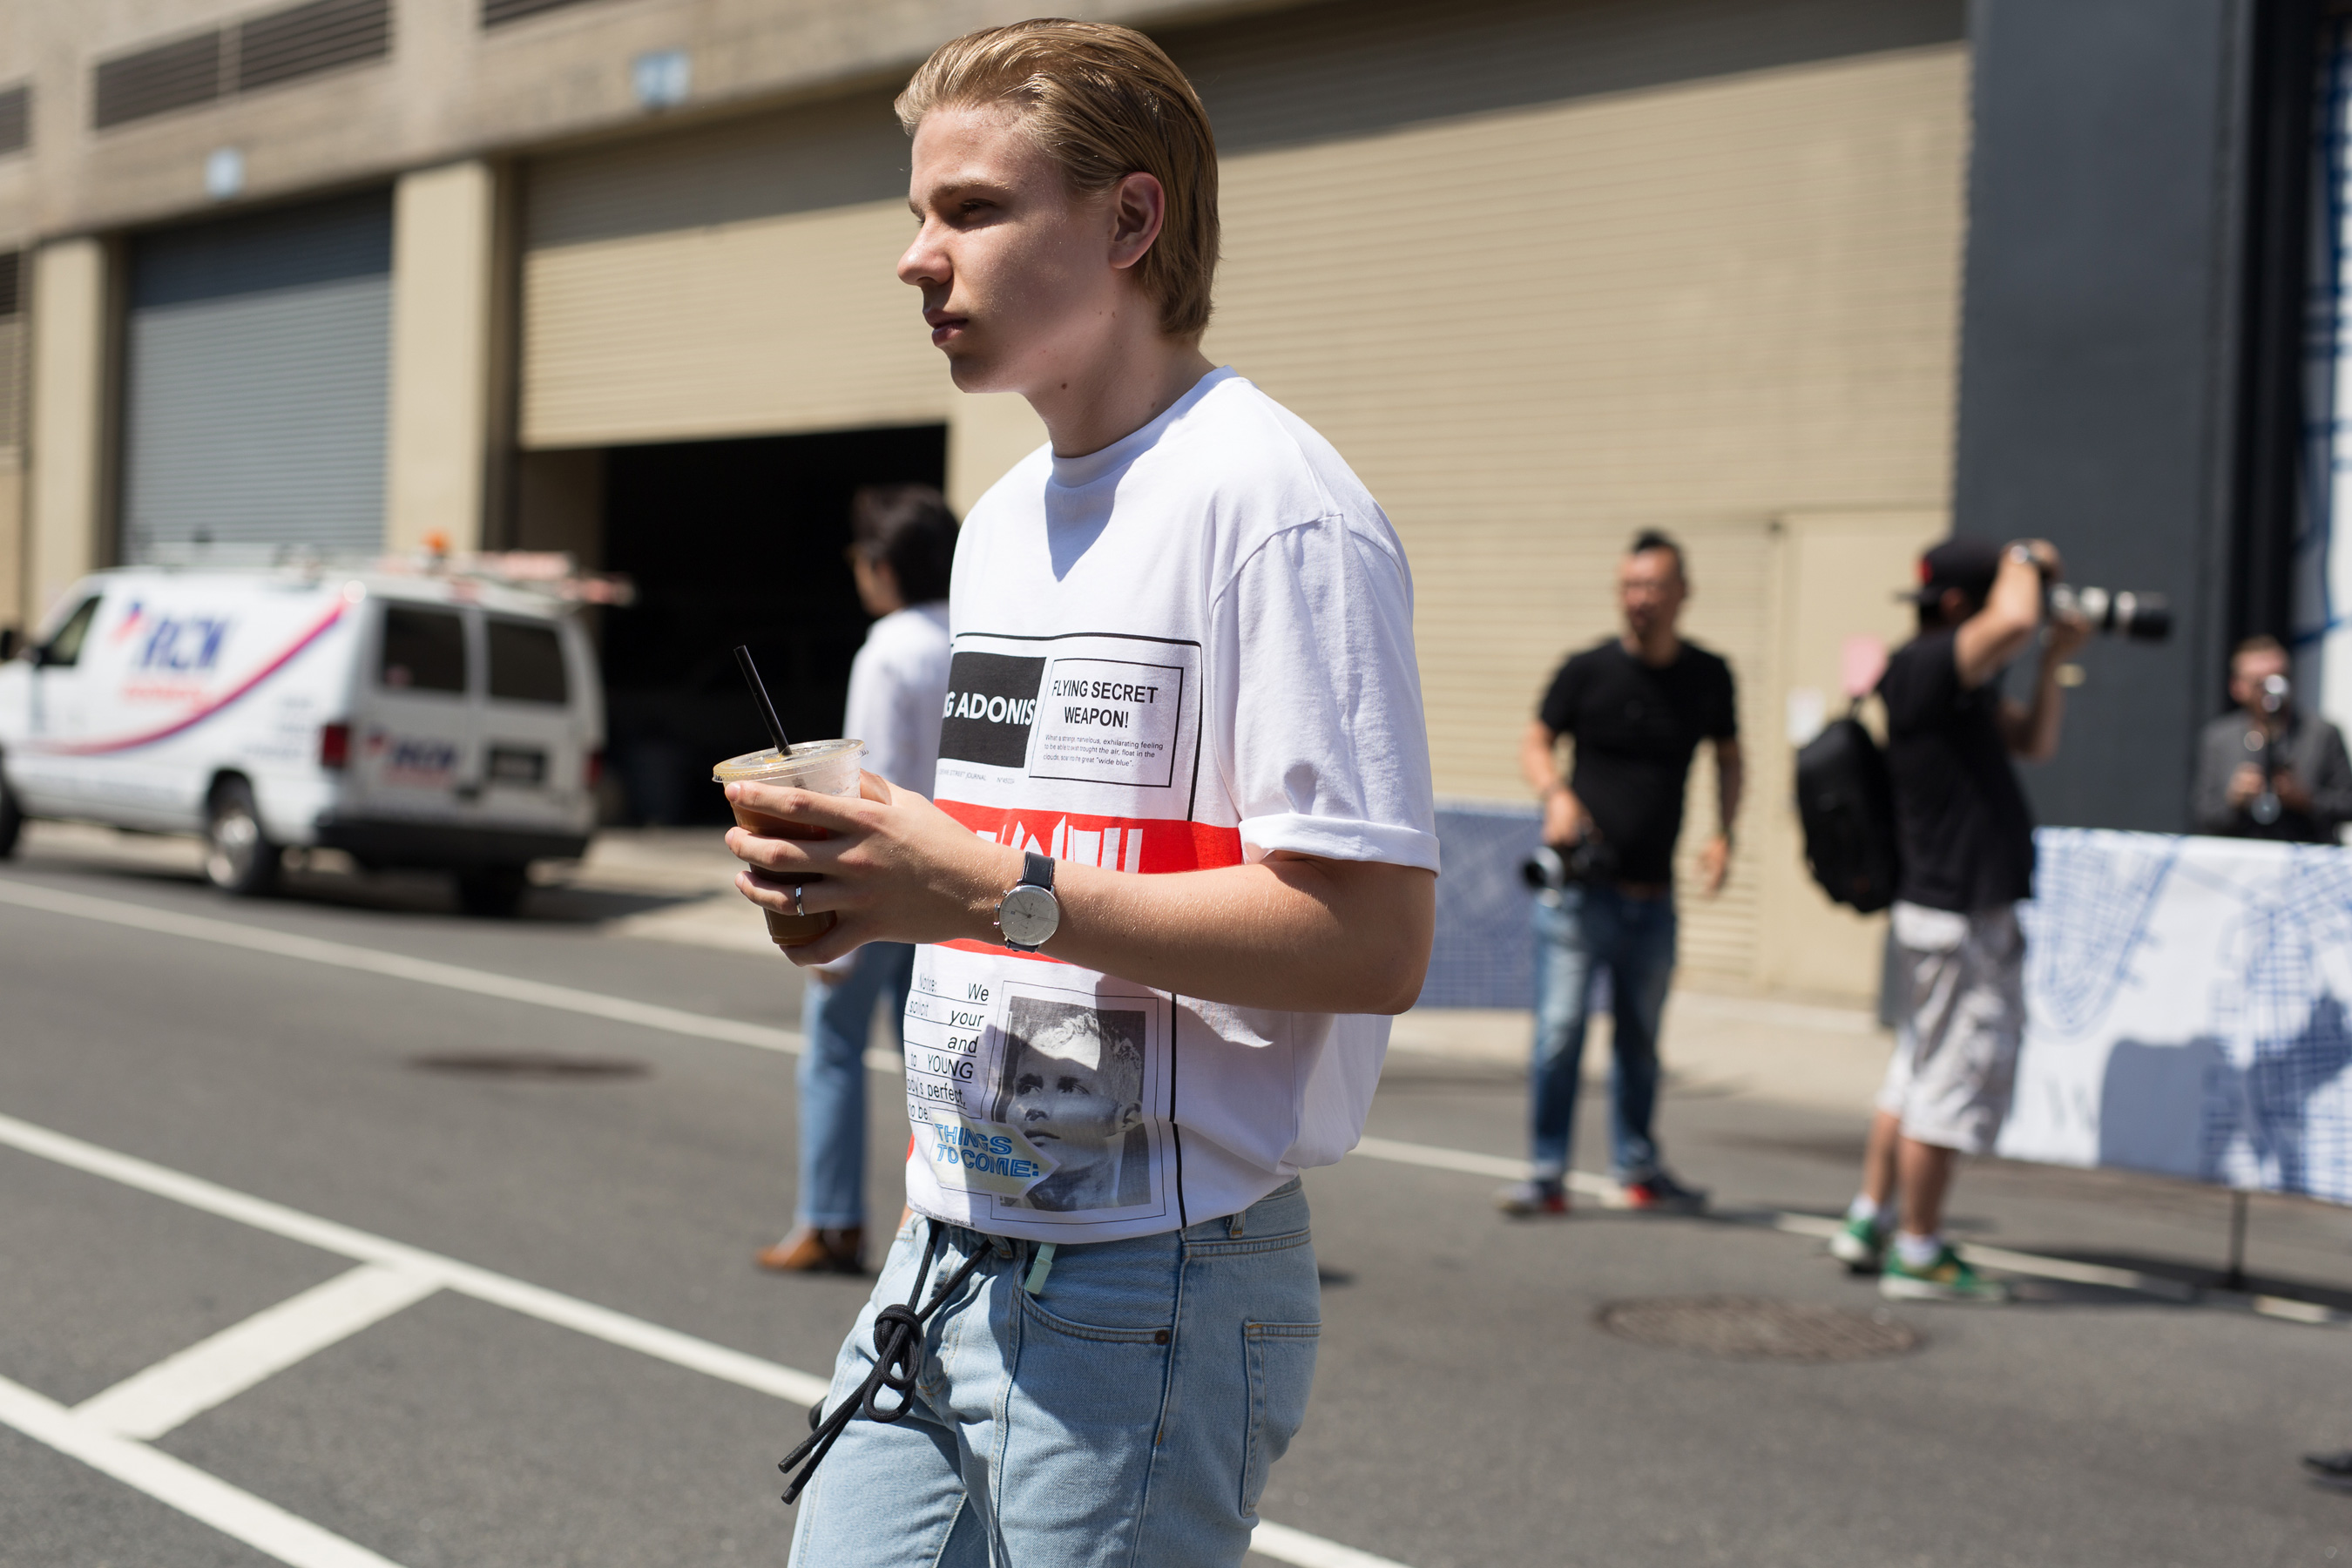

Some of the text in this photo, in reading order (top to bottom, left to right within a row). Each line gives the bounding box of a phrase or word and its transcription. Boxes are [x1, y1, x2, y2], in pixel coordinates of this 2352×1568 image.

[1051, 679, 1159, 704] FLYING SECRET
[954, 692, 1037, 726] ADONIS
[1064, 706, 1129, 728] WEAPON!
[1103, 739, 1139, 749] exhilarating
[1140, 741, 1163, 750] feeling
[968, 983, 989, 1002] We
[948, 1010, 984, 1027] your
[948, 1036, 979, 1053] and
[928, 1053, 974, 1079] YOUNG
[927, 1082, 966, 1107] perfect,
[934, 1123, 1012, 1155] THINGS
[936, 1143, 1039, 1178] TO COME:
